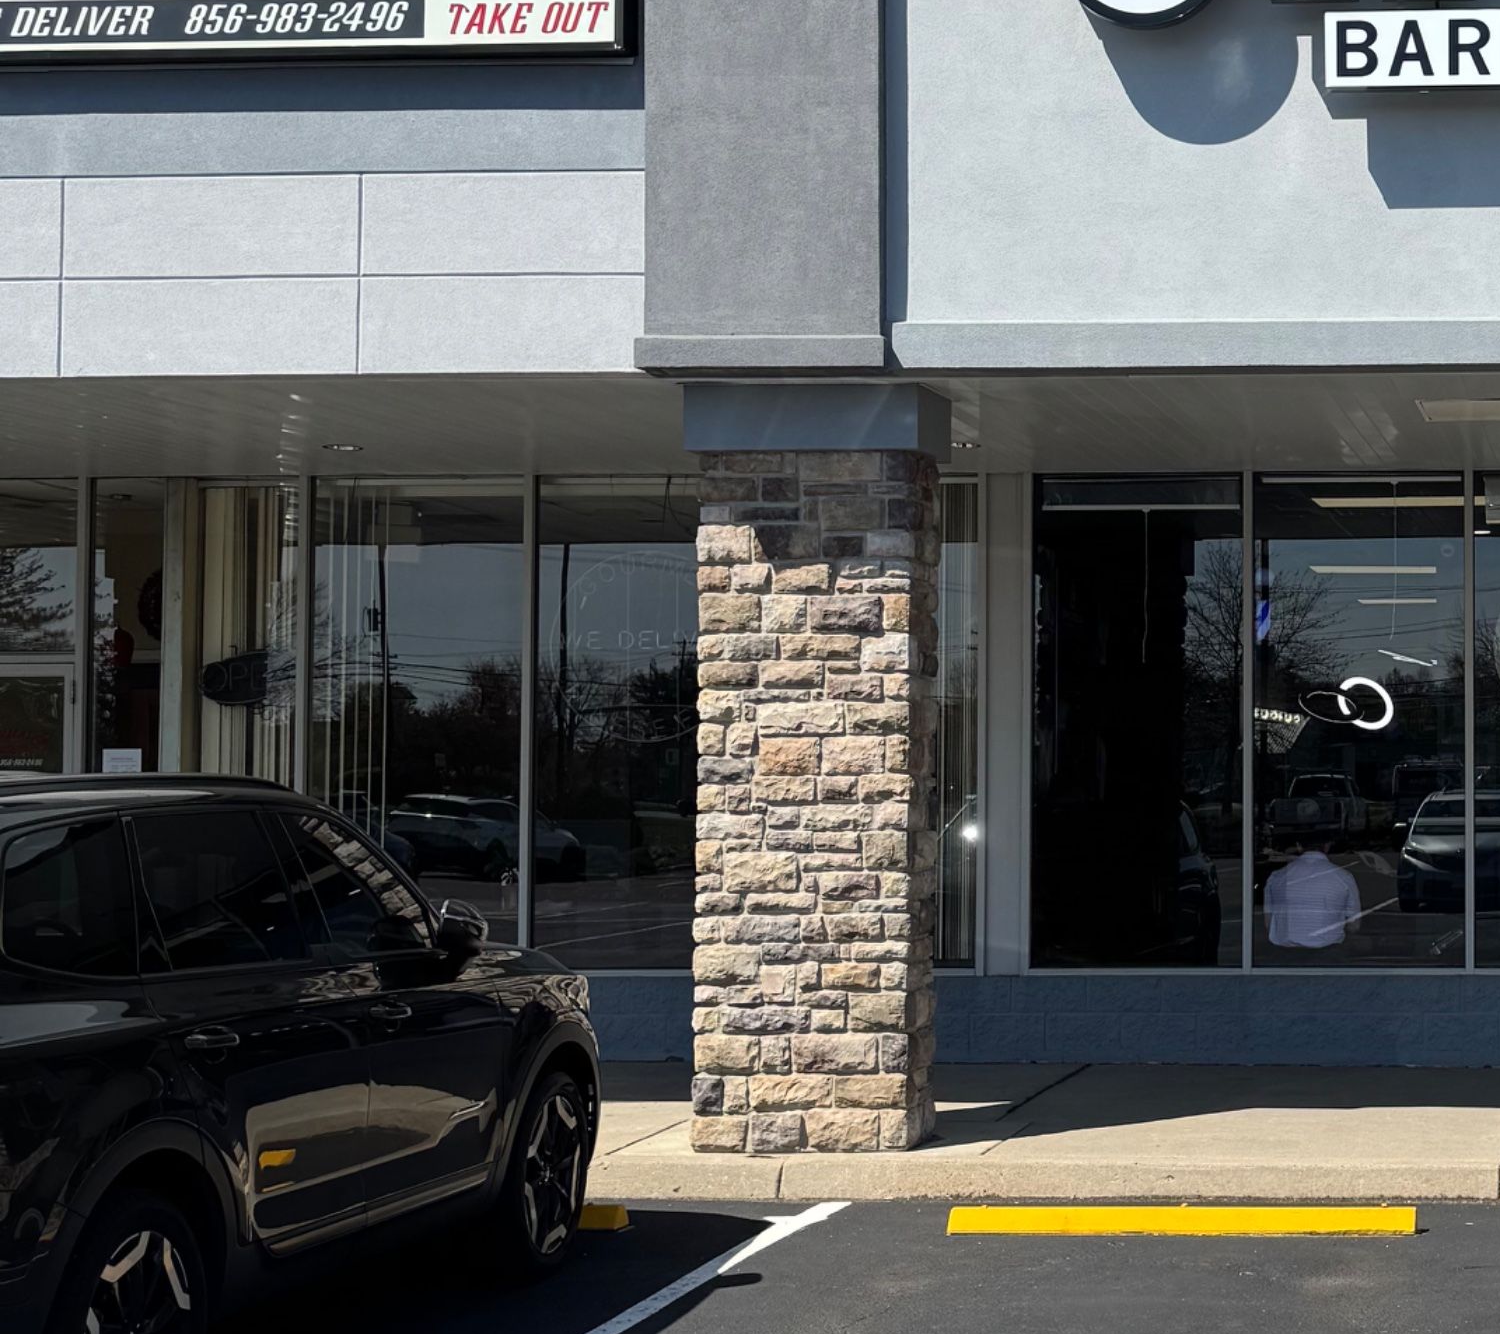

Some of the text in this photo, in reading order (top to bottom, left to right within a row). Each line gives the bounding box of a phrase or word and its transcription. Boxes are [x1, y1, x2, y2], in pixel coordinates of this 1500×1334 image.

[10, 0, 409, 38] DELIVER 856-983-2496
[448, 0, 609, 36] TAKE OUT
